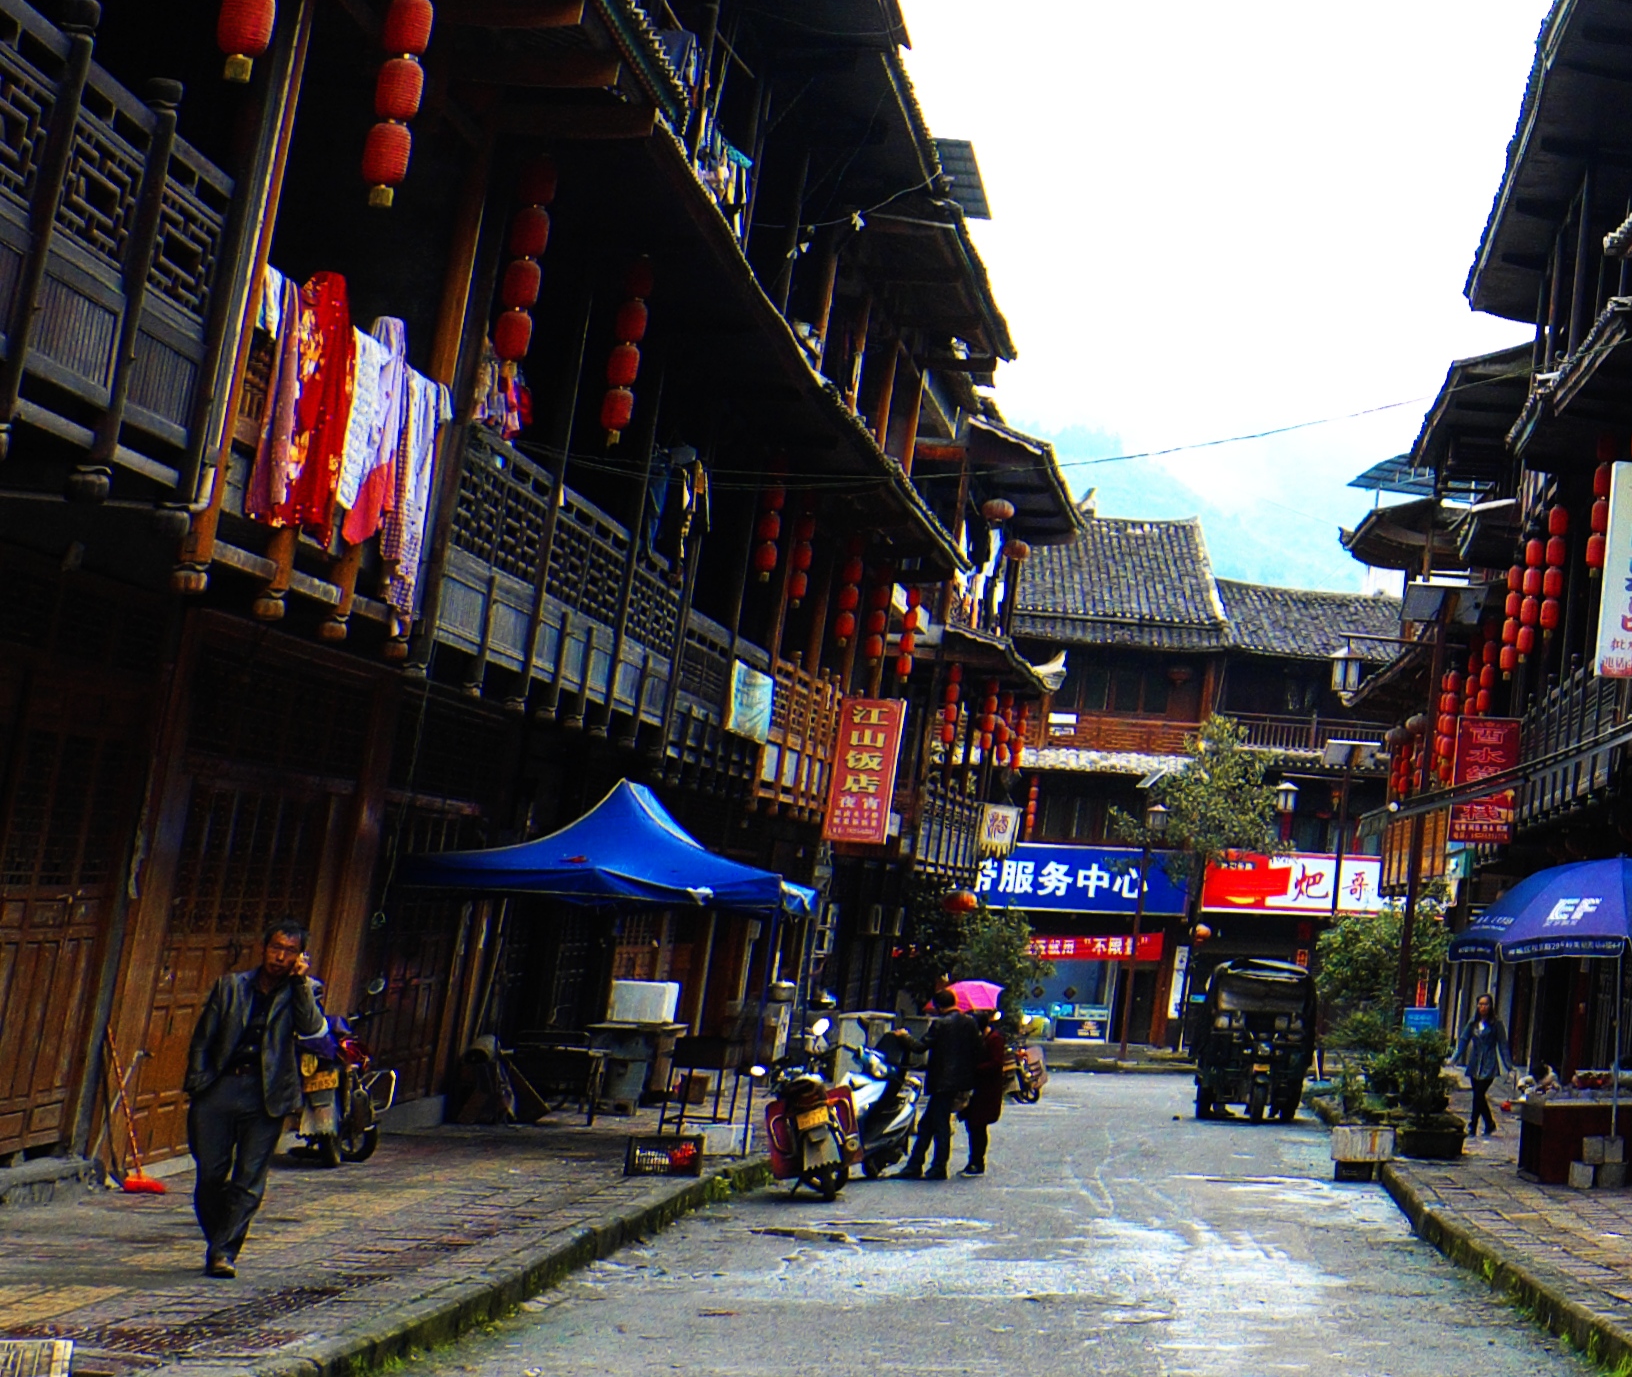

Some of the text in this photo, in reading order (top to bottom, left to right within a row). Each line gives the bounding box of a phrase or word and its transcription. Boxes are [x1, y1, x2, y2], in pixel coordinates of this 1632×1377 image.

[841, 705, 889, 794] 江山饭店
[1548, 897, 1602, 920] EF
